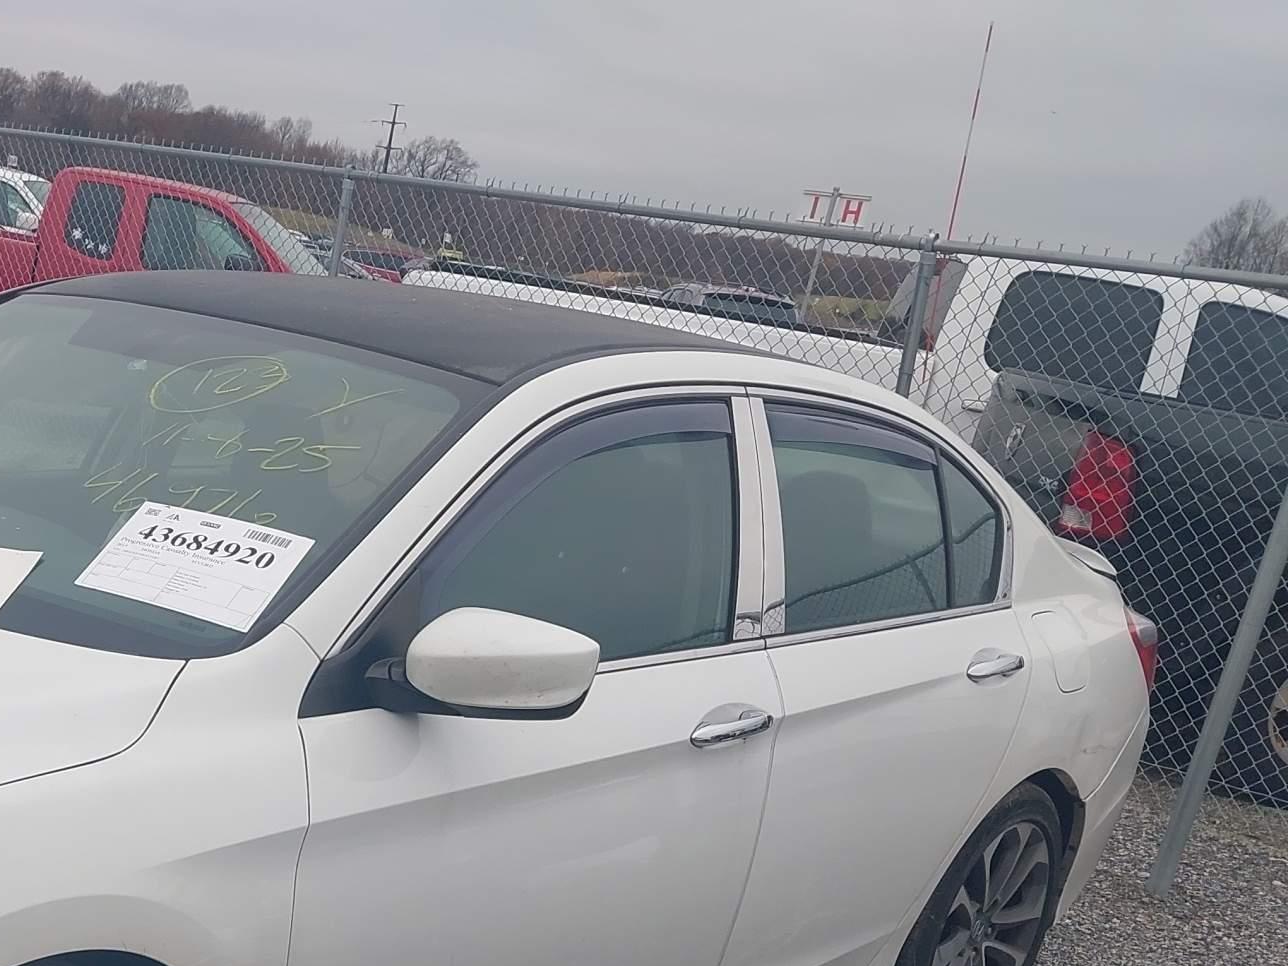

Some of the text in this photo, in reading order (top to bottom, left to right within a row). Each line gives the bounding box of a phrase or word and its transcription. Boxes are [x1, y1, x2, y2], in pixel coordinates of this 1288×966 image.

[841, 199, 863, 225] H
[120, 536, 160, 549] Progressive
[191, 553, 226, 566] Insurance
[138, 524, 275, 569] 43684920
